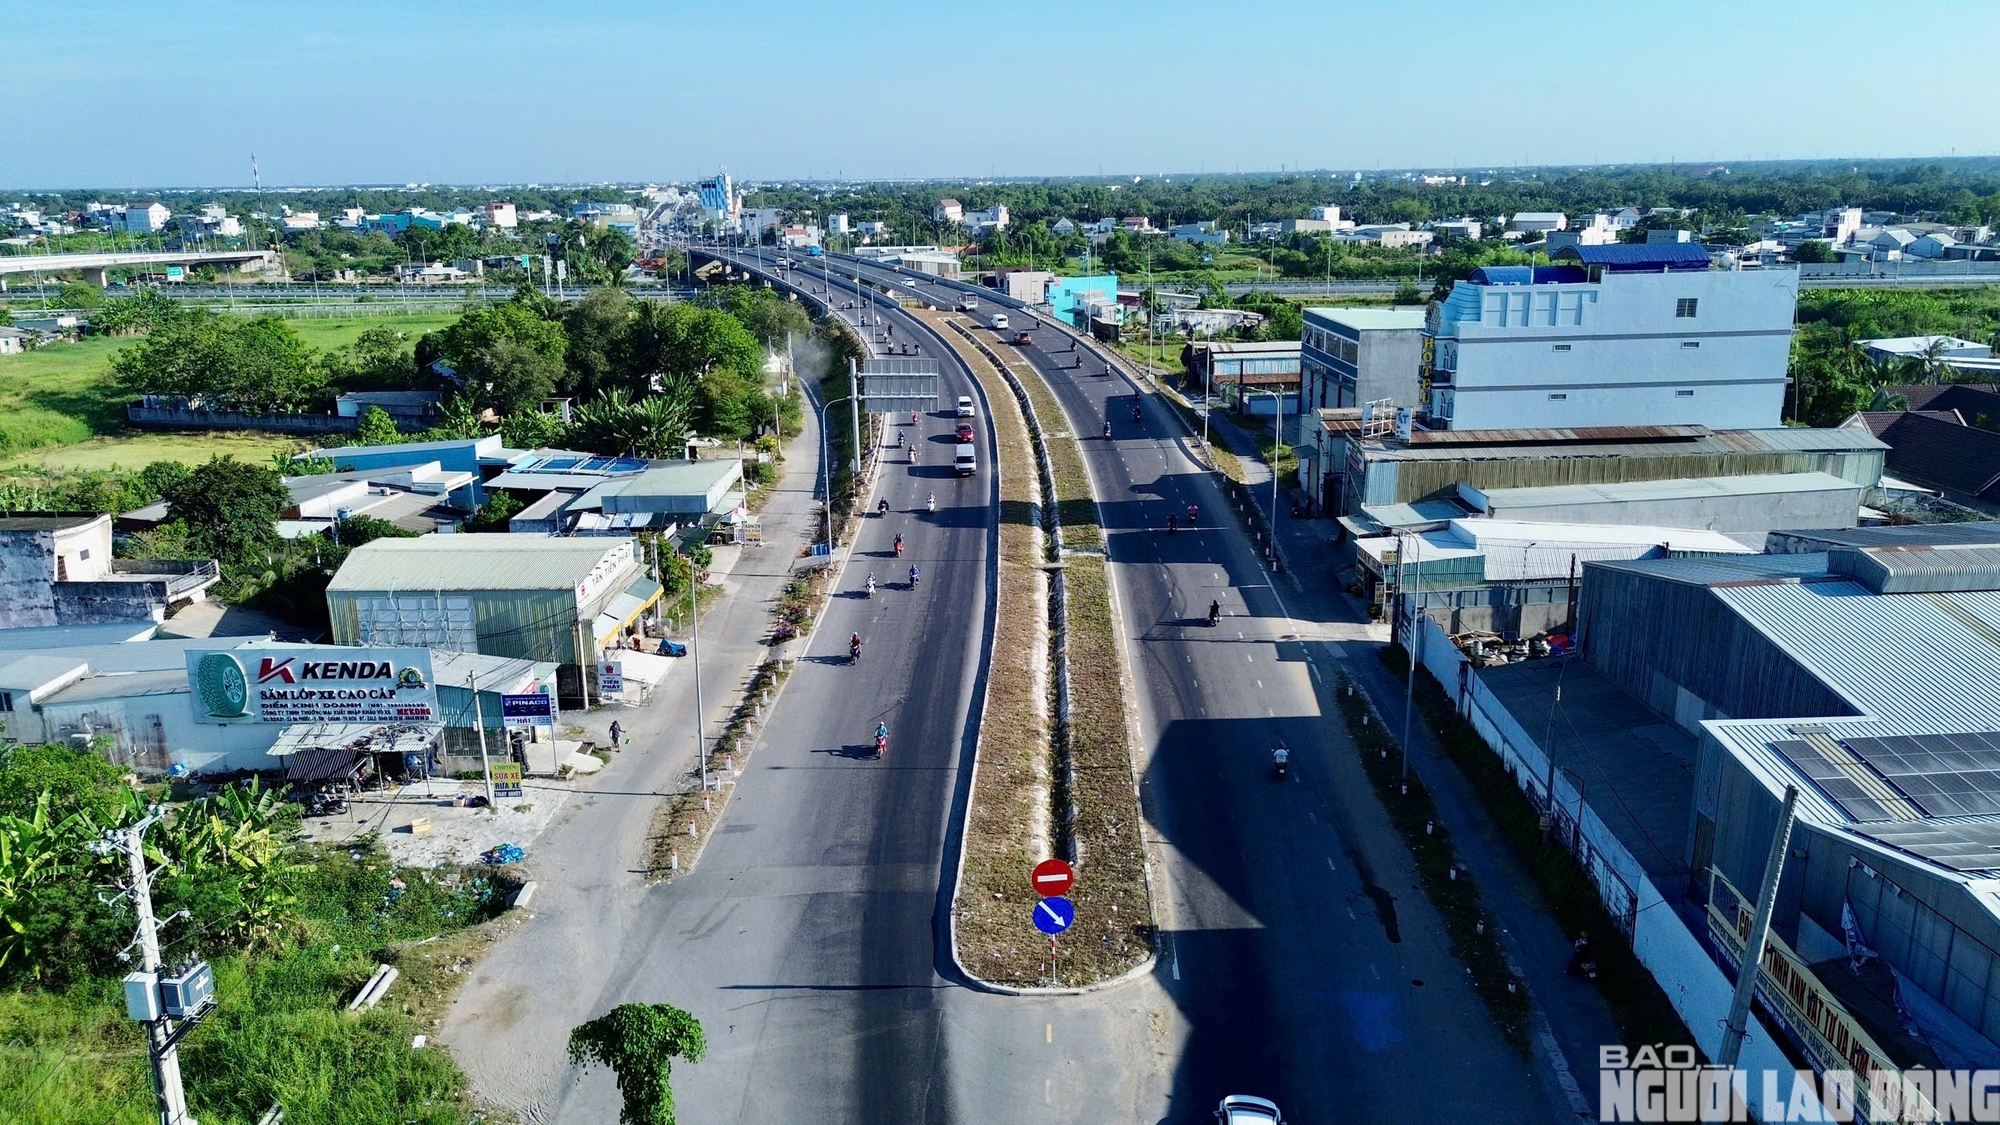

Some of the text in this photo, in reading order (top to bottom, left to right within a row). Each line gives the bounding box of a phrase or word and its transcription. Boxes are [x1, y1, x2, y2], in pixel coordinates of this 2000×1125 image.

[1422, 337, 1433, 403] HOTEL
[301, 662, 393, 680] KENDA
[260, 688, 289, 700] SĂM
[317, 690, 336, 700] XE
[338, 690, 367, 700] CAO
[397, 708, 431, 716] MEKONG
[1769, 943, 1789, 990] TNHH
[1789, 967, 1806, 1010] XNK
